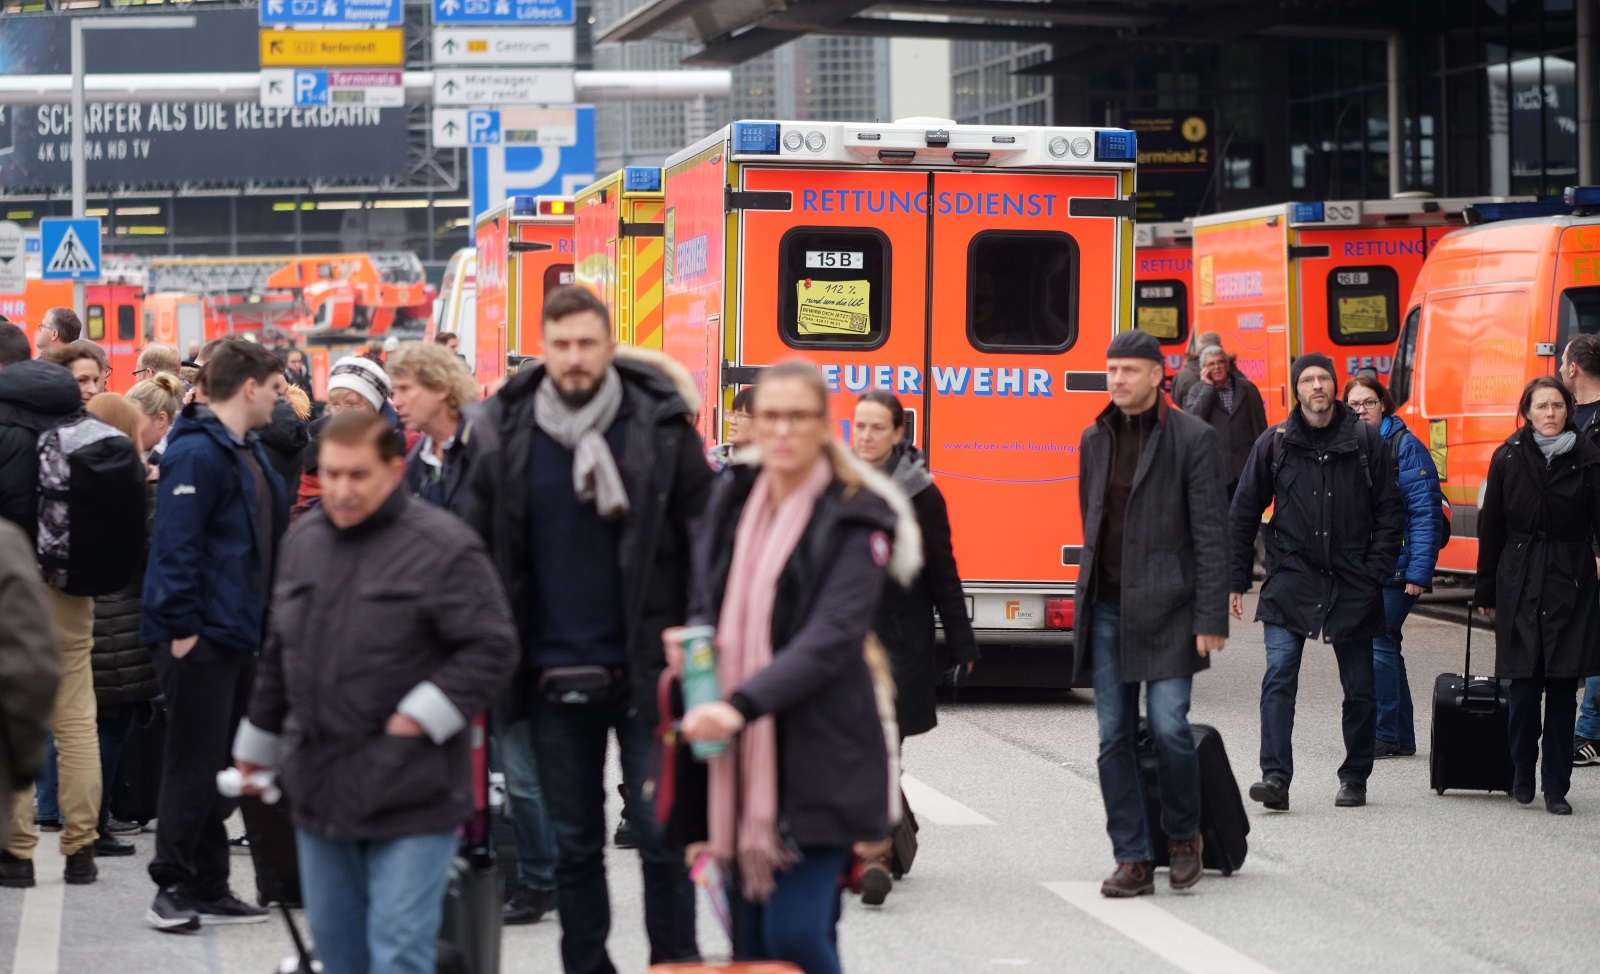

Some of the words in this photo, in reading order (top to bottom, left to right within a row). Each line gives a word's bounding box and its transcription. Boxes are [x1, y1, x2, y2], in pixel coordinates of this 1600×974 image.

[516, 7, 563, 19] Lübeck
[320, 42, 376, 53] Norderstedt
[495, 41, 550, 52] Centrum
[296, 74, 317, 102] P
[332, 72, 395, 86] Terminals
[465, 75, 539, 88] Mietwagen/
[465, 90, 485, 99] car
[492, 89, 528, 99] rental
[148, 101, 187, 132] ALS
[194, 100, 228, 130] DIE
[235, 102, 380, 130] REEPERBAHN
[471, 112, 492, 143] P
[37, 142, 55, 162] 4K
[107, 139, 128, 160] HD
[132, 138, 150, 159] TV
[1137, 149, 1196, 163] erminal
[1198, 147, 1208, 163] 2
[803, 189, 1058, 217] RETTUNGSDIENST
[817, 252, 836, 267] 15
[840, 252, 852, 267] B
[1338, 274, 1352, 285] 16
[1353, 274, 1361, 284] B
[825, 284, 843, 294] 112
[821, 364, 1053, 397] EUERWEHR
[1471, 375, 1518, 400] FEUERWEHR
